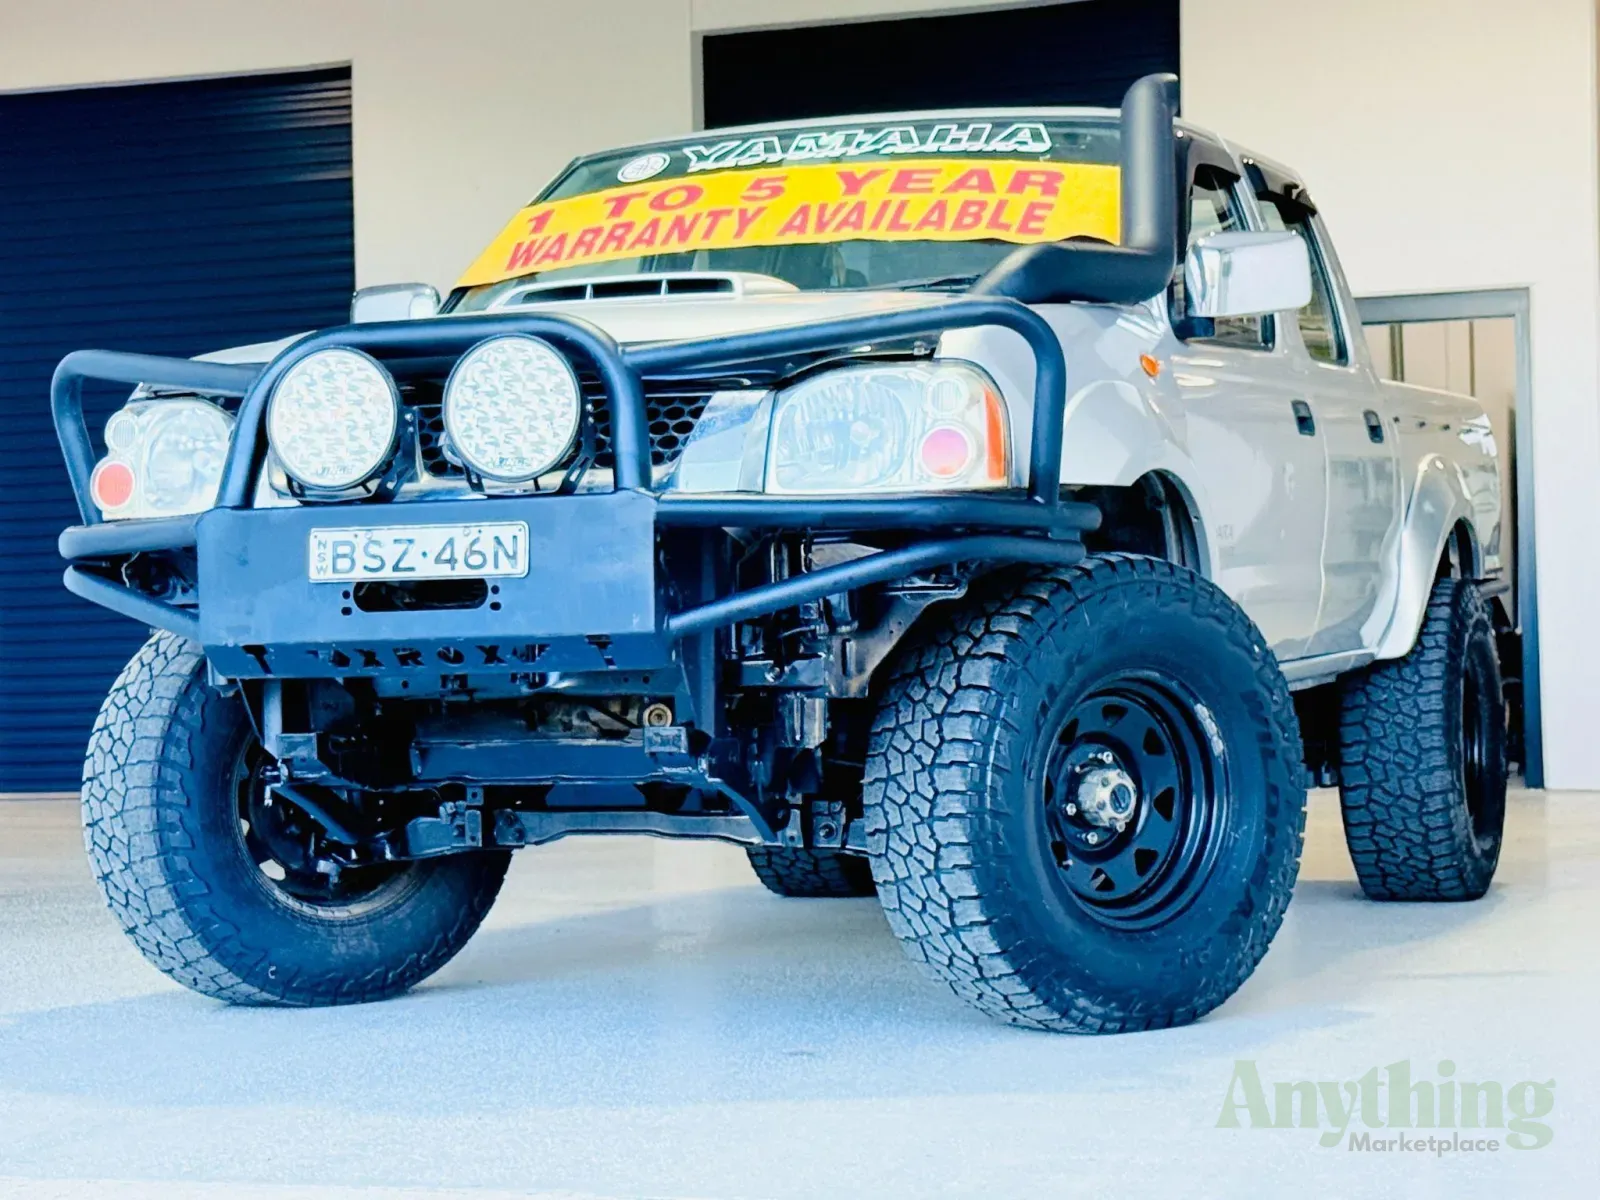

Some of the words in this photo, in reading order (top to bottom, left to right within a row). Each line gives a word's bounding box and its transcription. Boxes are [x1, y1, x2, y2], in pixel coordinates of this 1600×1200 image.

[683, 123, 1052, 172] YAMAHA
[504, 205, 769, 272] WARRANTY
[776, 199, 1055, 237] AVAILABLE
[527, 208, 556, 236] 1
[602, 184, 705, 220] TO
[739, 175, 789, 203] 5
[836, 168, 1066, 198] YEAR
